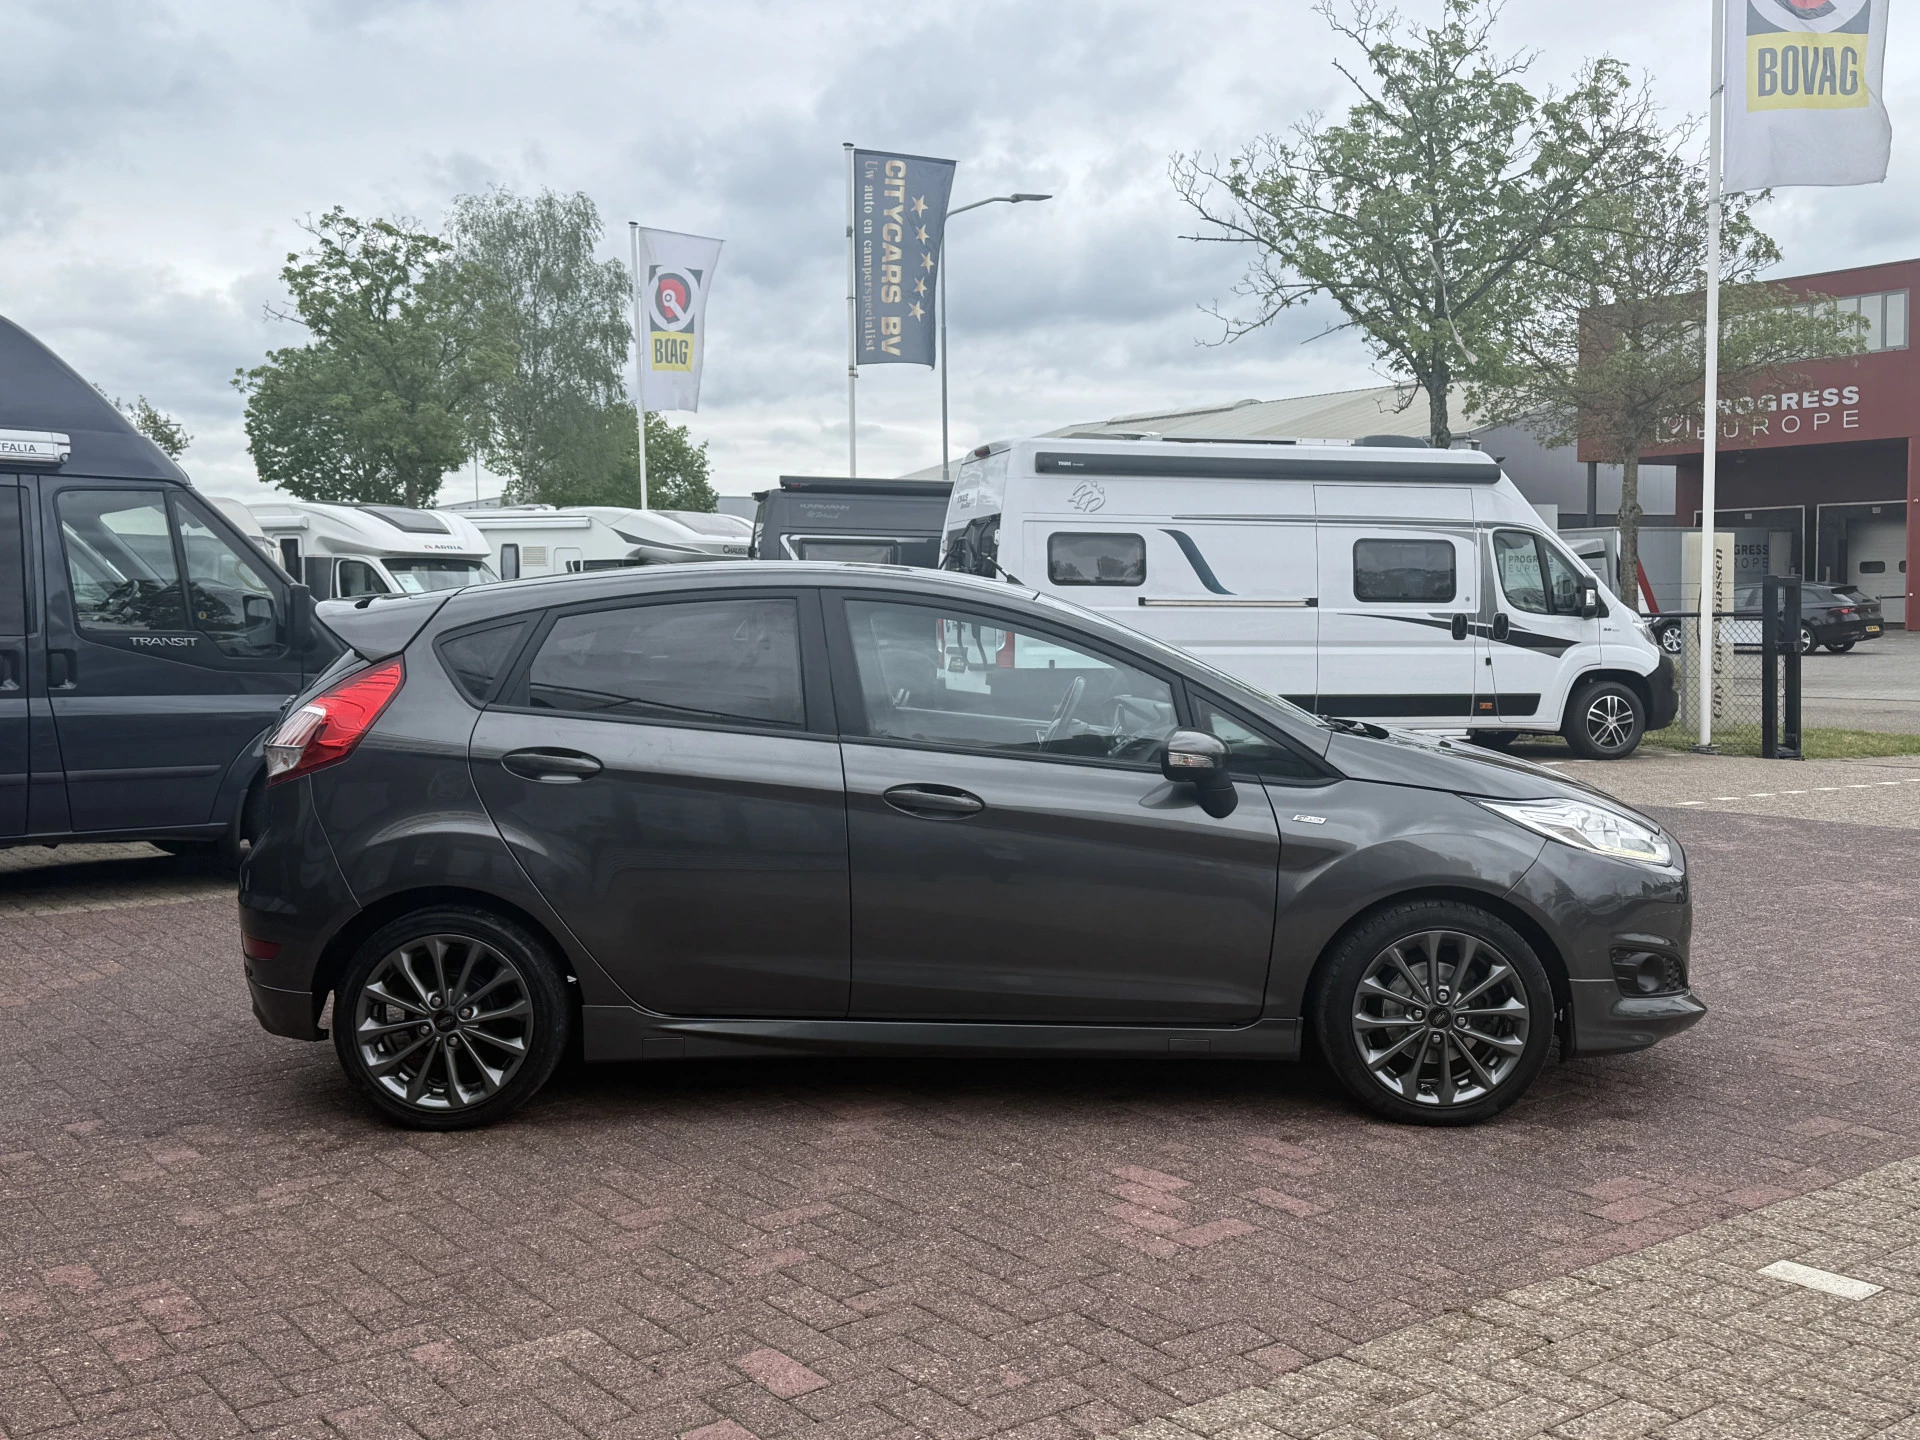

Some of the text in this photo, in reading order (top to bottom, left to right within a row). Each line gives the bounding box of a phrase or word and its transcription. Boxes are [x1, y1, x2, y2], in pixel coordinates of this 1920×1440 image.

[1757, 45, 1859, 97] BOVAG
[861, 160, 878, 352] Uw auto en camperspecialist
[881, 159, 907, 356] CITYCARS BV
[1697, 386, 1860, 416] ROGRESS
[0, 442, 37, 453] FALIA
[722, 544, 748, 555] CHAUSS
[1508, 555, 1554, 563] PROGRS
[1734, 544, 1769, 555] GRESS
[1508, 564, 1554, 572] EUROE
[129, 637, 198, 647] TRANSIT
[1713, 630, 1723, 675] Cars
[1713, 684, 1724, 719] City
